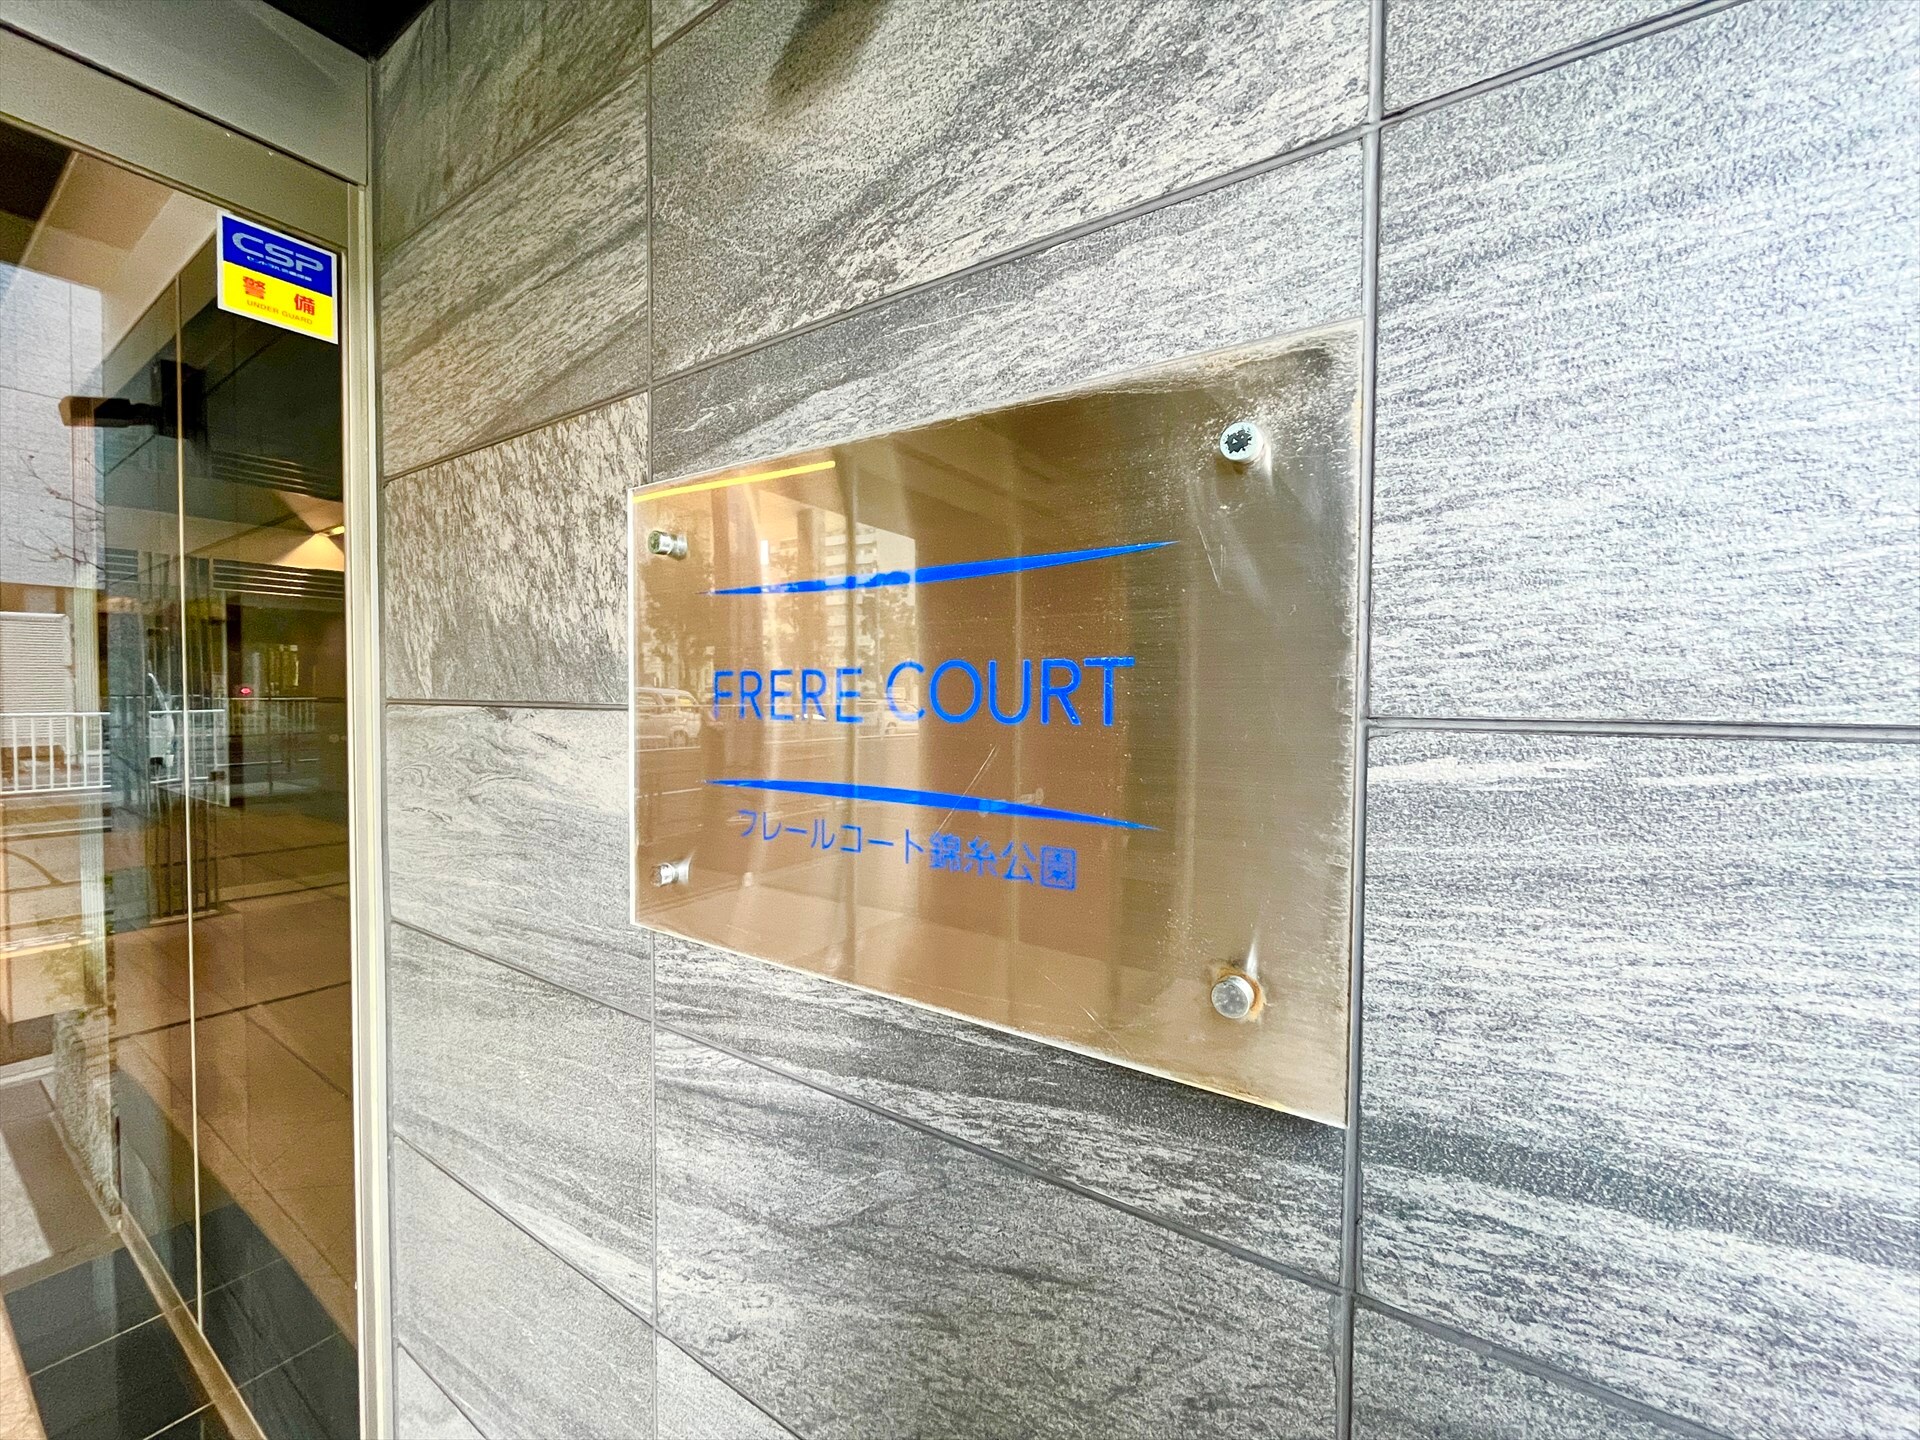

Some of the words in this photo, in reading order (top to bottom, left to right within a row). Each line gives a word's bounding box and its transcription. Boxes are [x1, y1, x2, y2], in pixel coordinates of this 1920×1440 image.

[232, 232, 324, 272] CSP
[246, 299, 279, 315] UNDER
[281, 310, 313, 325] GUARD
[711, 667, 864, 724] FRERE
[886, 655, 1136, 727] COURT
[738, 808, 1077, 891] フレールコート錦糸公園
